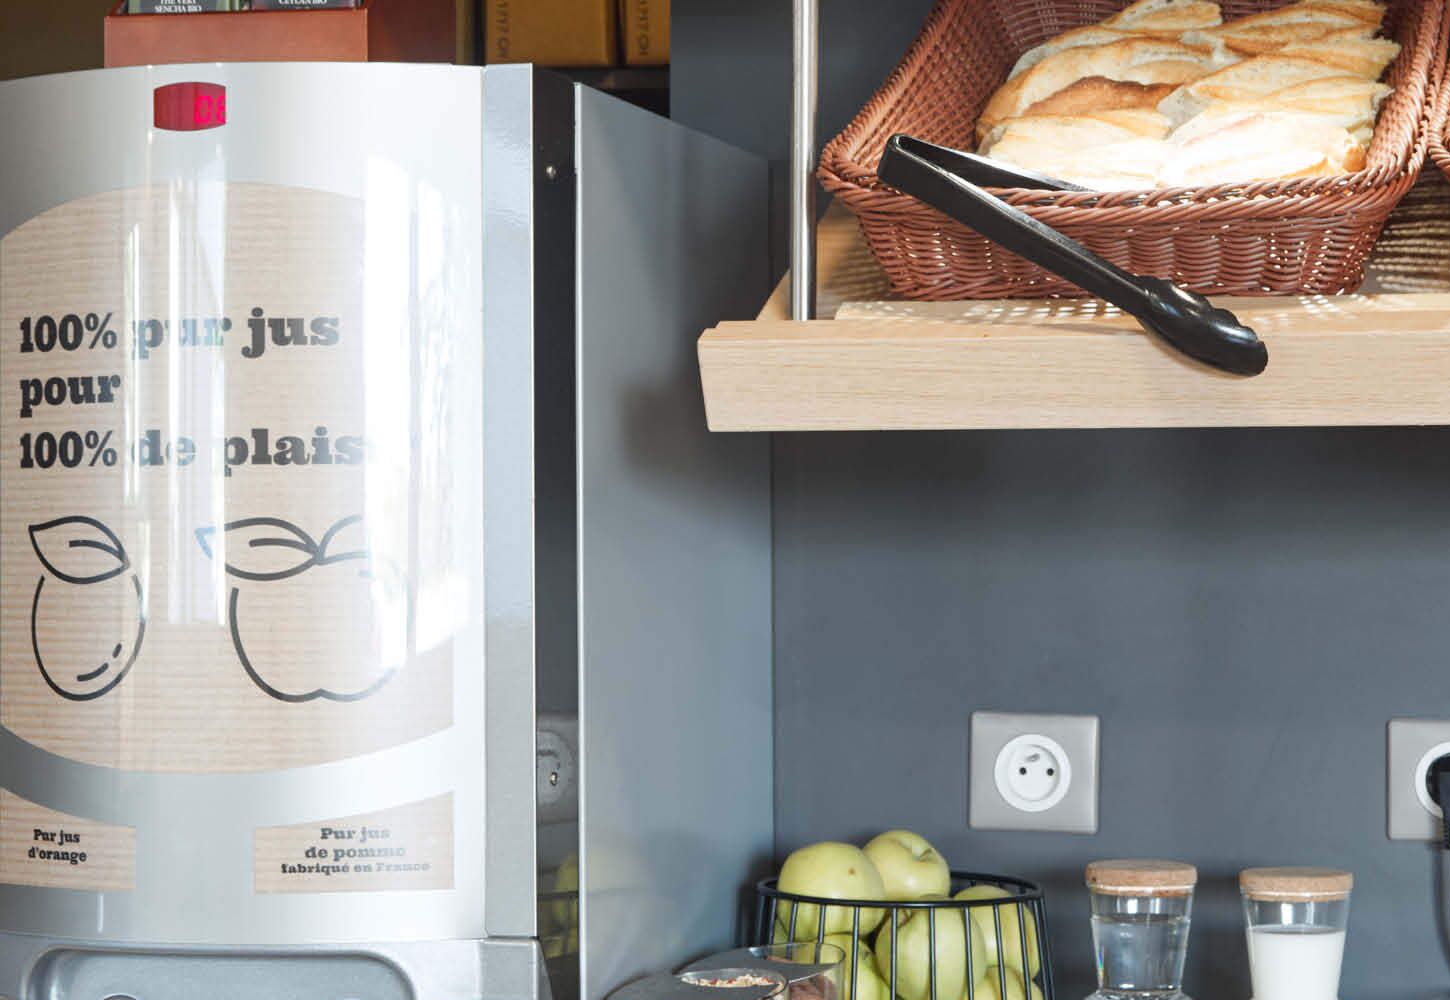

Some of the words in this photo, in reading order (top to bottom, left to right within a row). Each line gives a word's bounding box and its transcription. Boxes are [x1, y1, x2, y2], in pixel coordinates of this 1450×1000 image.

[187, 4, 202, 12] BIO
[19, 312, 118, 353] 100%
[131, 314, 232, 360] pur
[240, 307, 340, 359] jus
[19, 373, 121, 418] pour
[19, 430, 118, 469] 100%
[131, 429, 196, 466] de
[32, 828, 57, 842] Pur
[58, 829, 81, 846] jus
[320, 827, 357, 840] Pur
[359, 826, 391, 842] jus
[27, 846, 88, 865] d'orange
[304, 846, 329, 859] de
[333, 846, 406, 862] pomme
[280, 862, 350, 876] fabriqué
[353, 862, 373, 873] en
